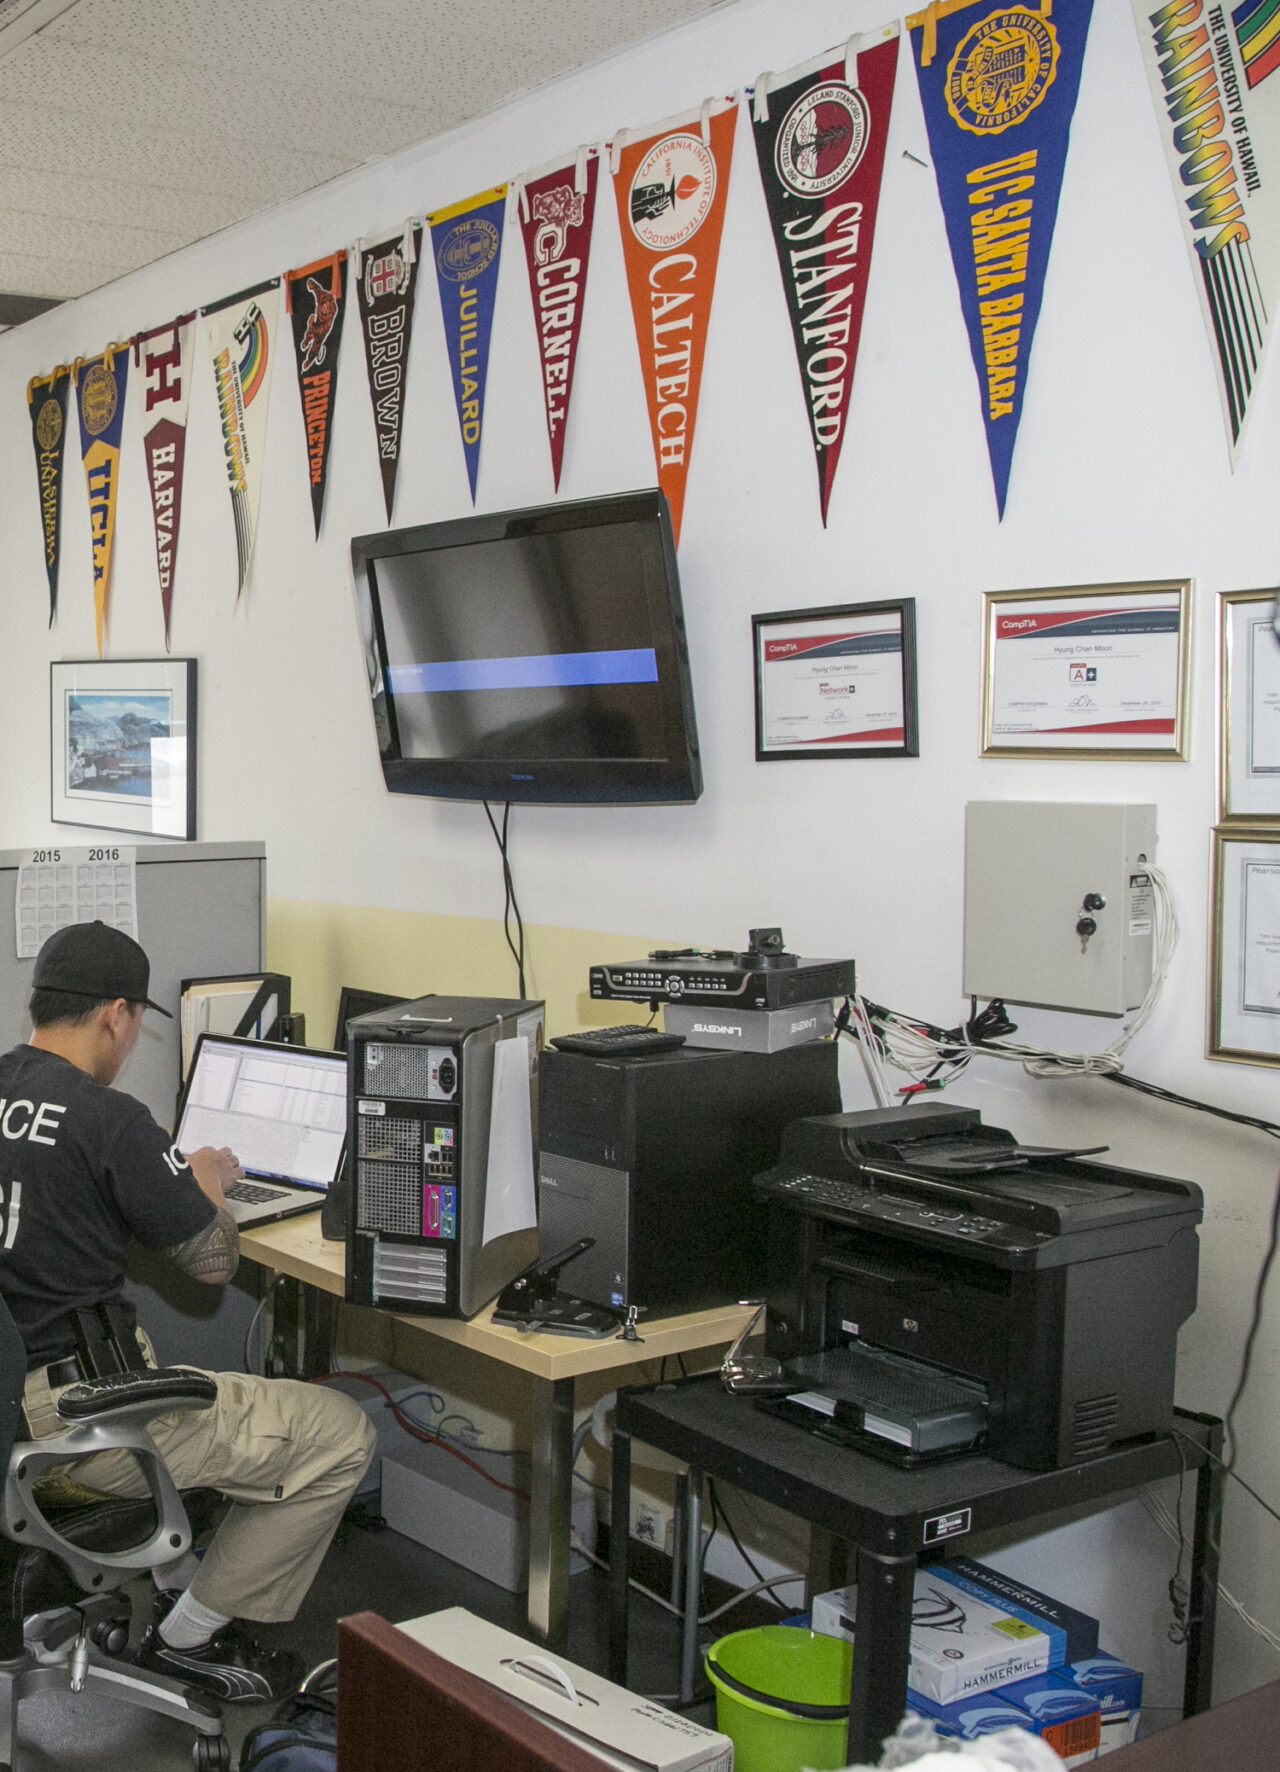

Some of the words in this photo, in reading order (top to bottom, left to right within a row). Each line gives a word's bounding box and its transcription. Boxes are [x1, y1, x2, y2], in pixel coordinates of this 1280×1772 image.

[975, 20, 998, 40] THE
[1001, 14, 1052, 58] UNIVERSITY
[1208, 5, 1226, 35] THE
[1039, 62, 1050, 78] OF
[1213, 34, 1244, 114] UNIVERSITY
[807, 90, 835, 106] LELAND
[835, 91, 860, 120] STANFORD
[975, 83, 1042, 126] CALIFORNIA
[782, 117, 797, 167] ORGANIZED
[852, 121, 863, 154] JUNIOR
[1148, 0, 1250, 259] RAINBOWS
[1230, 115, 1248, 134] OF
[642, 140, 692, 177] CALIFORNIA
[693, 147, 712, 198] INSTITUTE
[809, 157, 853, 189] UNIVERSITY
[1236, 136, 1262, 192] HAWAII
[697, 200, 708, 215] OF
[642, 217, 698, 244] TECHNOLOGY
[783, 202, 864, 446] STANFORD
[459, 283, 481, 445] JUILLIARD
[536, 257, 581, 434] CORNELL
[648, 253, 698, 469] CALTECH
[979, 293, 1025, 420] BARBARA
[145, 341, 183, 412] H
[368, 304, 406, 460] BROWN
[213, 347, 247, 497] RAINBOWS
[232, 376, 243, 420] UNIVERSITY
[241, 433, 250, 464] HAWAII
[303, 370, 331, 484] PRINCETON
[152, 442, 176, 590] HARVARD
[1002, 619, 1037, 630] CompTIA
[769, 643, 798, 654] CompTIA
[1053, 645, 1074, 654] Hyung
[1075, 645, 1093, 653] Chan
[32, 849, 61, 863] 2015
[88, 848, 120, 861] 2016
[694, 1023, 742, 1037] LINKSYS
[790, 1017, 817, 1032] LINKSYS
[540, 1175, 558, 1187] DELL
[958, 1564, 1061, 1620] HAMMERMILL
[958, 1579, 989, 1599] COPY
[988, 1597, 1020, 1613] PLUS
[963, 1658, 1042, 1691] HAMMERMILL
